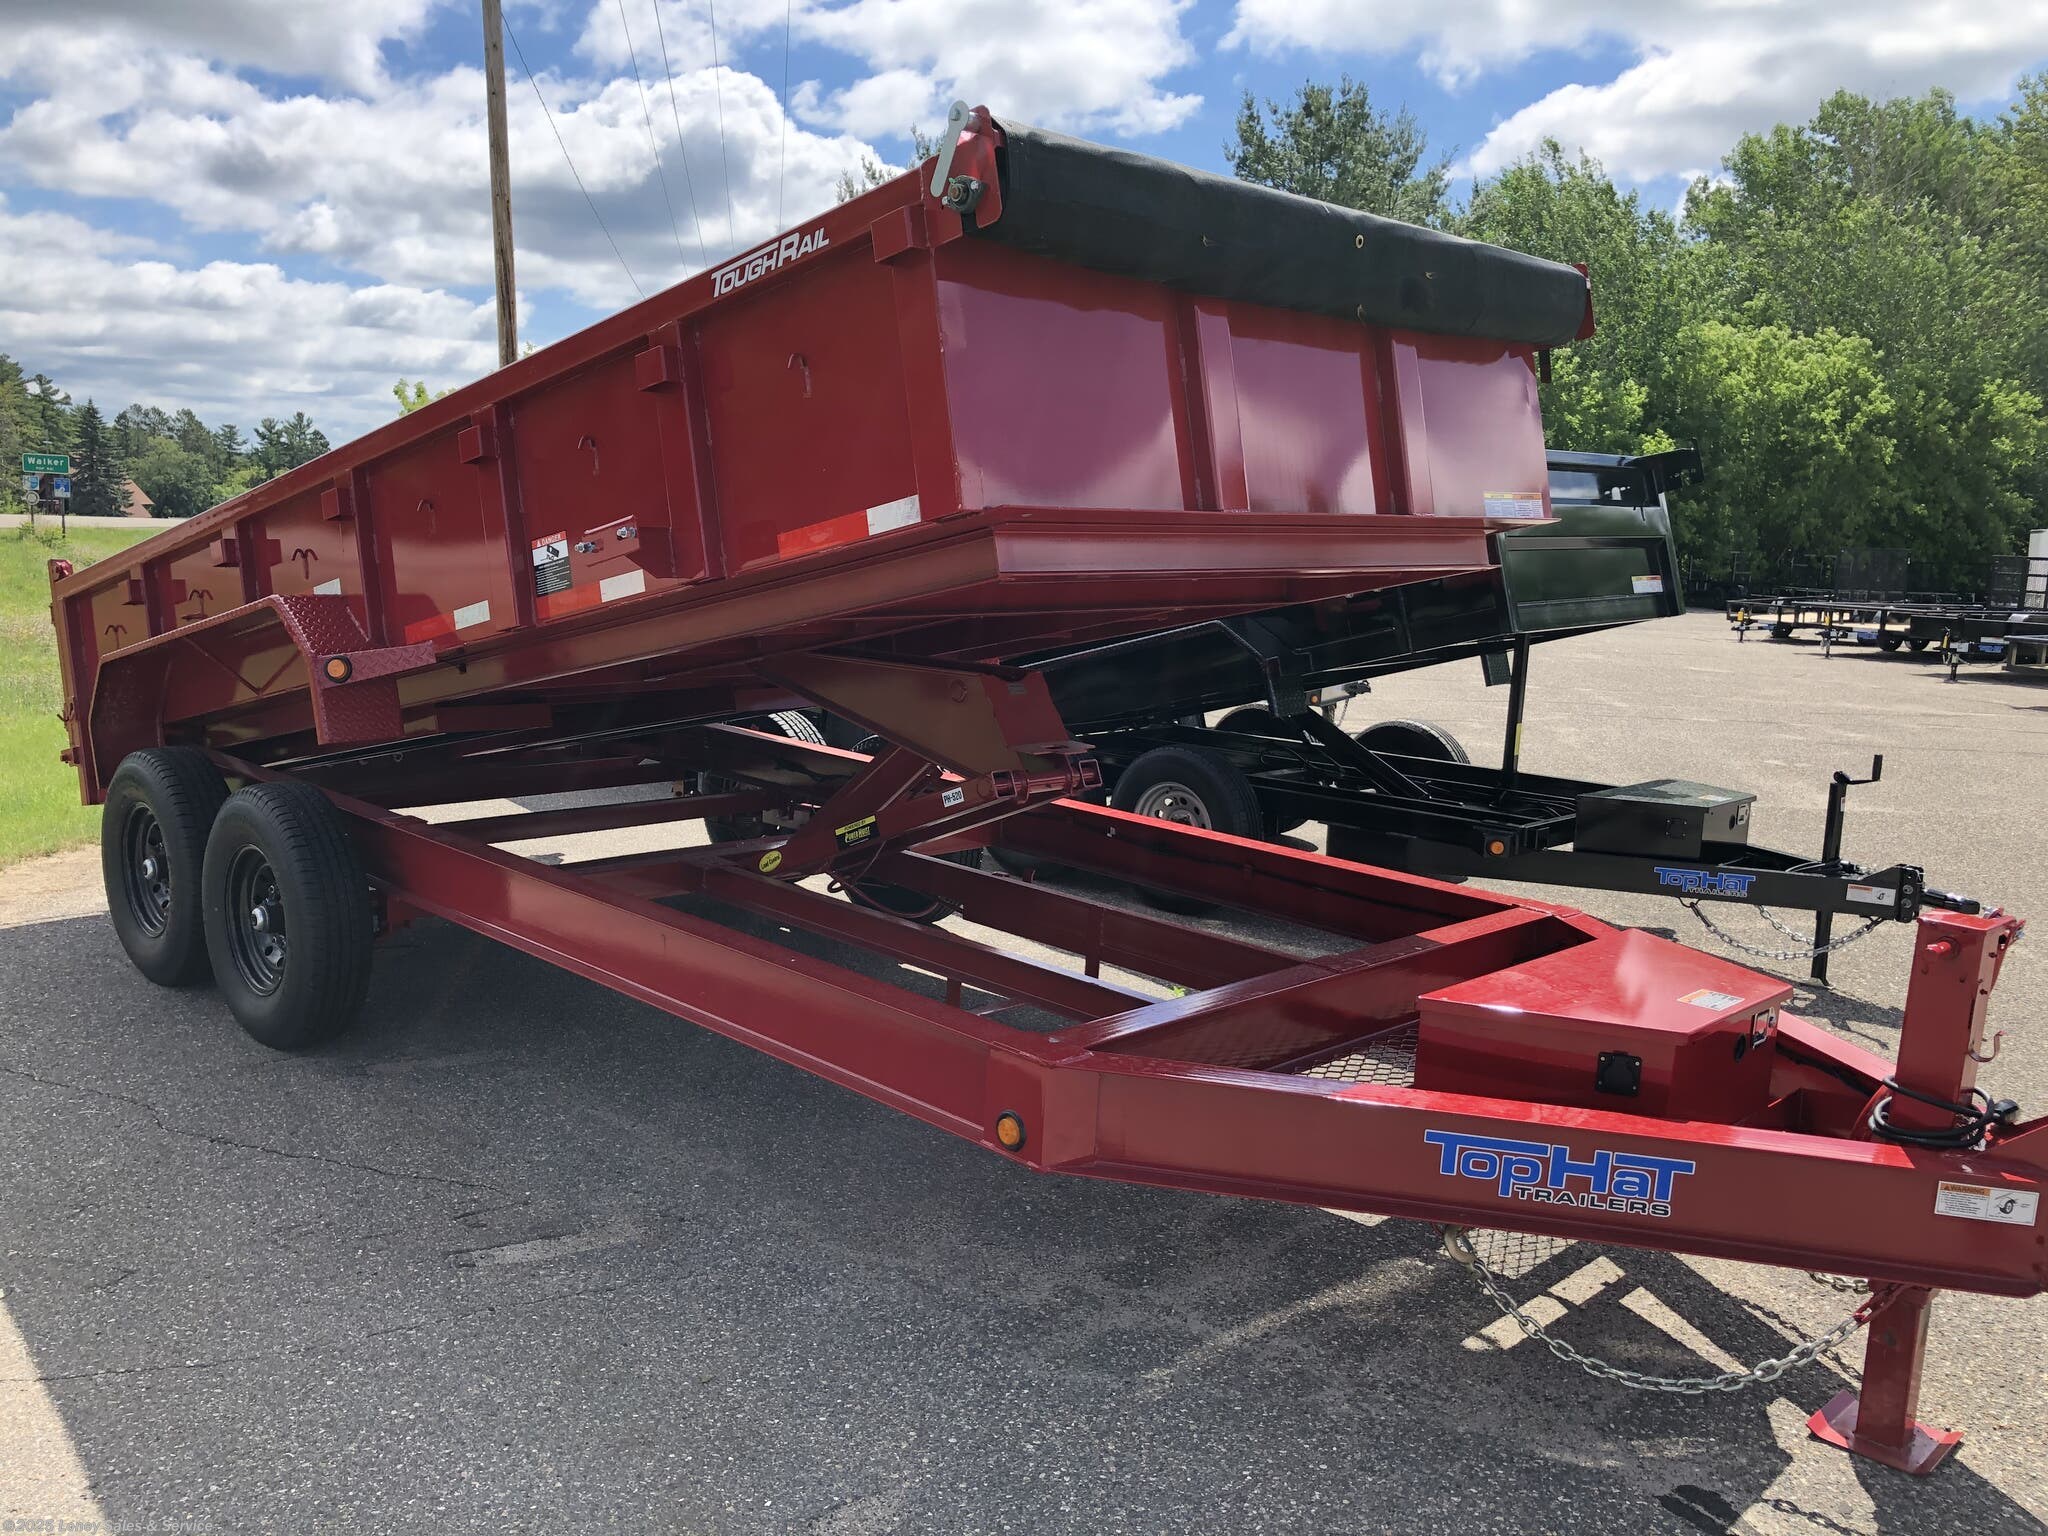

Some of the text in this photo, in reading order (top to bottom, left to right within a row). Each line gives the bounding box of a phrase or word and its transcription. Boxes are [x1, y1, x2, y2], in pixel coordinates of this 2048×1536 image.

[27, 456, 65, 466] Walker
[1951, 1184, 1986, 1195] WARNING
[1514, 1185, 1671, 1217] TRAILERS
